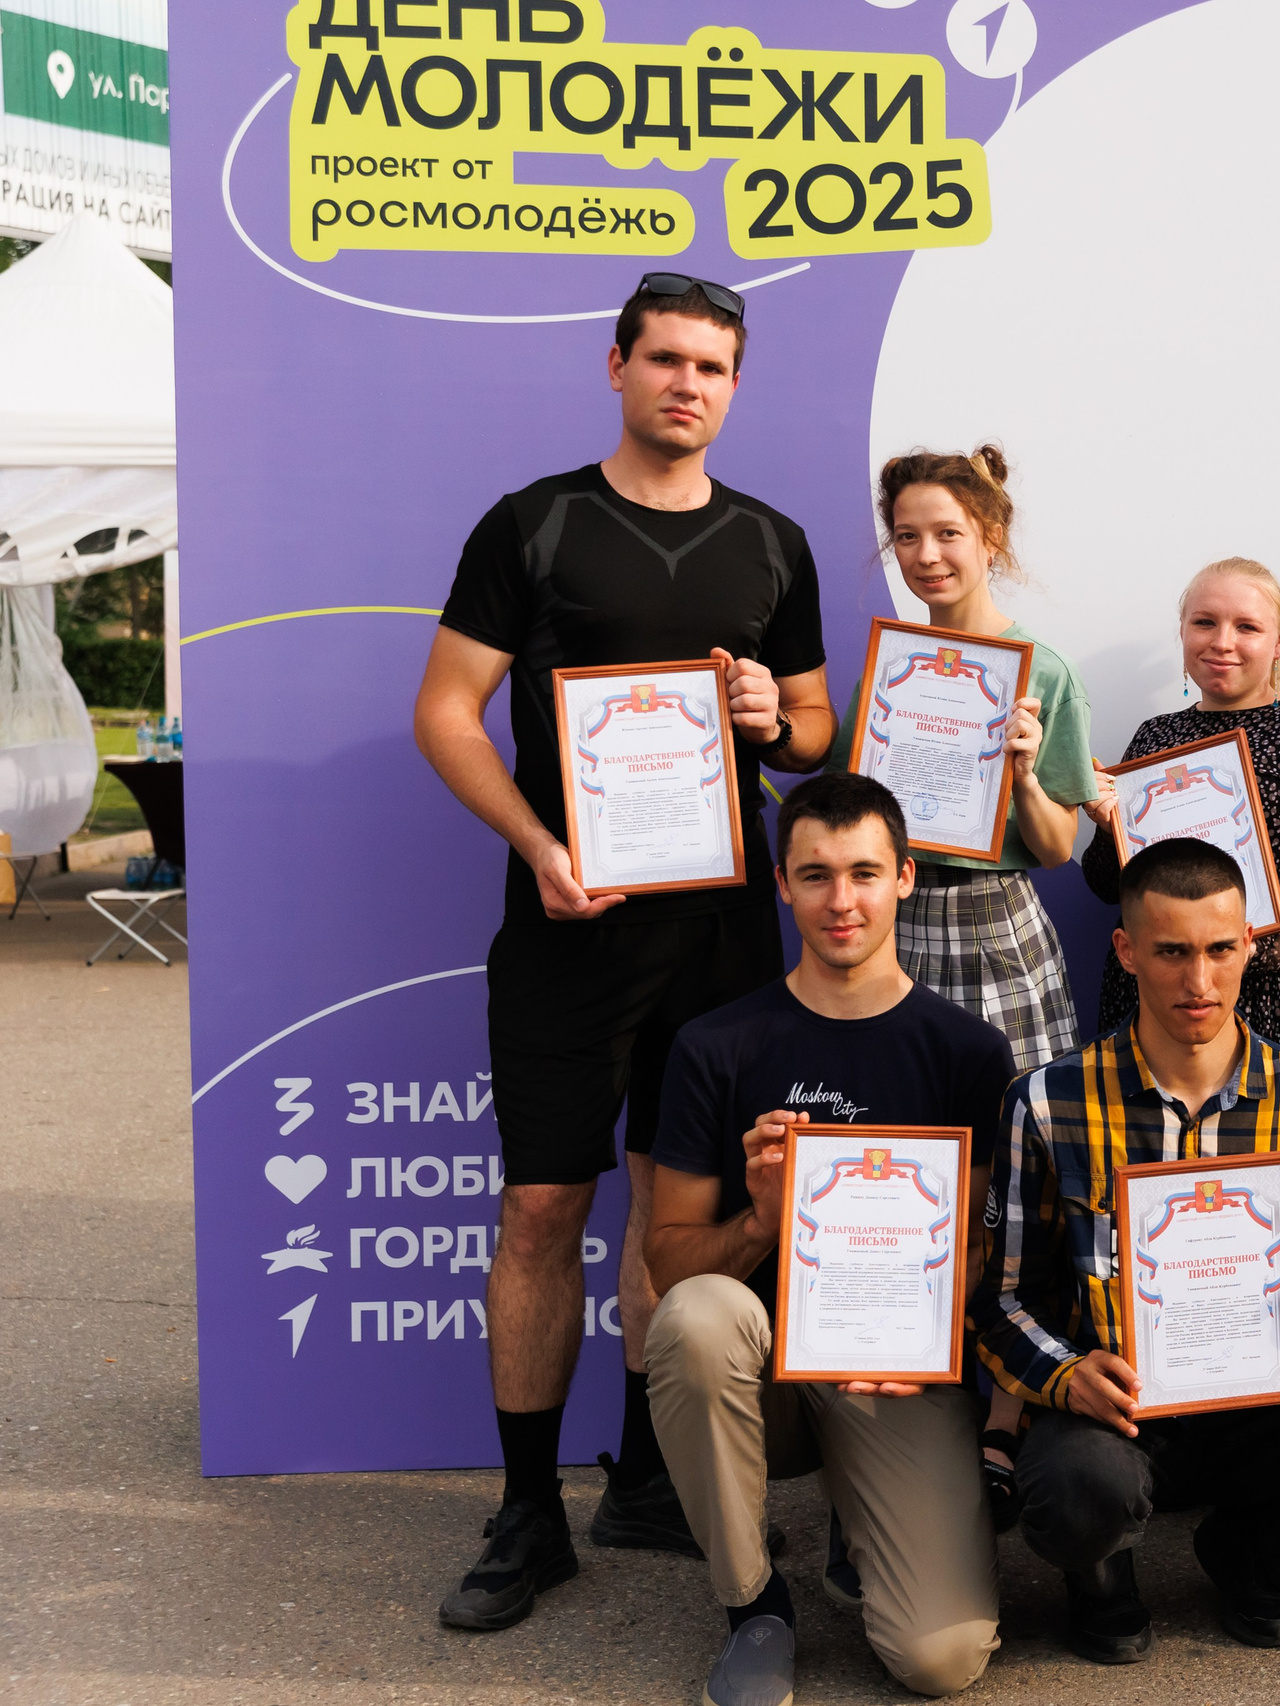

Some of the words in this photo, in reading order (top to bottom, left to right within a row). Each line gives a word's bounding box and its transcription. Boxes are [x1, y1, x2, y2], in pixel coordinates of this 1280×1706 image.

[308, 0, 584, 51] ДЕНЬ
[88, 70, 123, 99] ул.
[311, 46, 924, 151] МОЛОДЁЖИ
[310, 155, 439, 184] проект
[452, 158, 493, 180] от
[2, 179, 75, 214] РАЦИЯ
[744, 158, 974, 239] 2025
[311, 197, 676, 242] росмолодёжь
[896, 709, 982, 730] БЛАГОДАРСТВЕННОЕ
[916, 722, 959, 736] ПИСЬМО
[604, 750, 696, 765] БЛАГОДАРСТВЕННОЕ
[628, 761, 674, 773] ПИСЬМО
[346, 1072, 499, 1124] ЗНАЙ
[785, 1081, 842, 1104] Moskow
[832, 1097, 869, 1123] City
[824, 1225, 923, 1236] БЛАГОДАРСТВЕННОЕ
[848, 1236, 898, 1247] ПИСЬМО
[350, 1226, 608, 1274] ГОРДЬ
[1163, 1253, 1260, 1270] БЛАГОДАРСТВЕННОЕ
[1188, 1265, 1236, 1279] ПИСЬМО
[351, 1296, 623, 1342] ПРИУО
